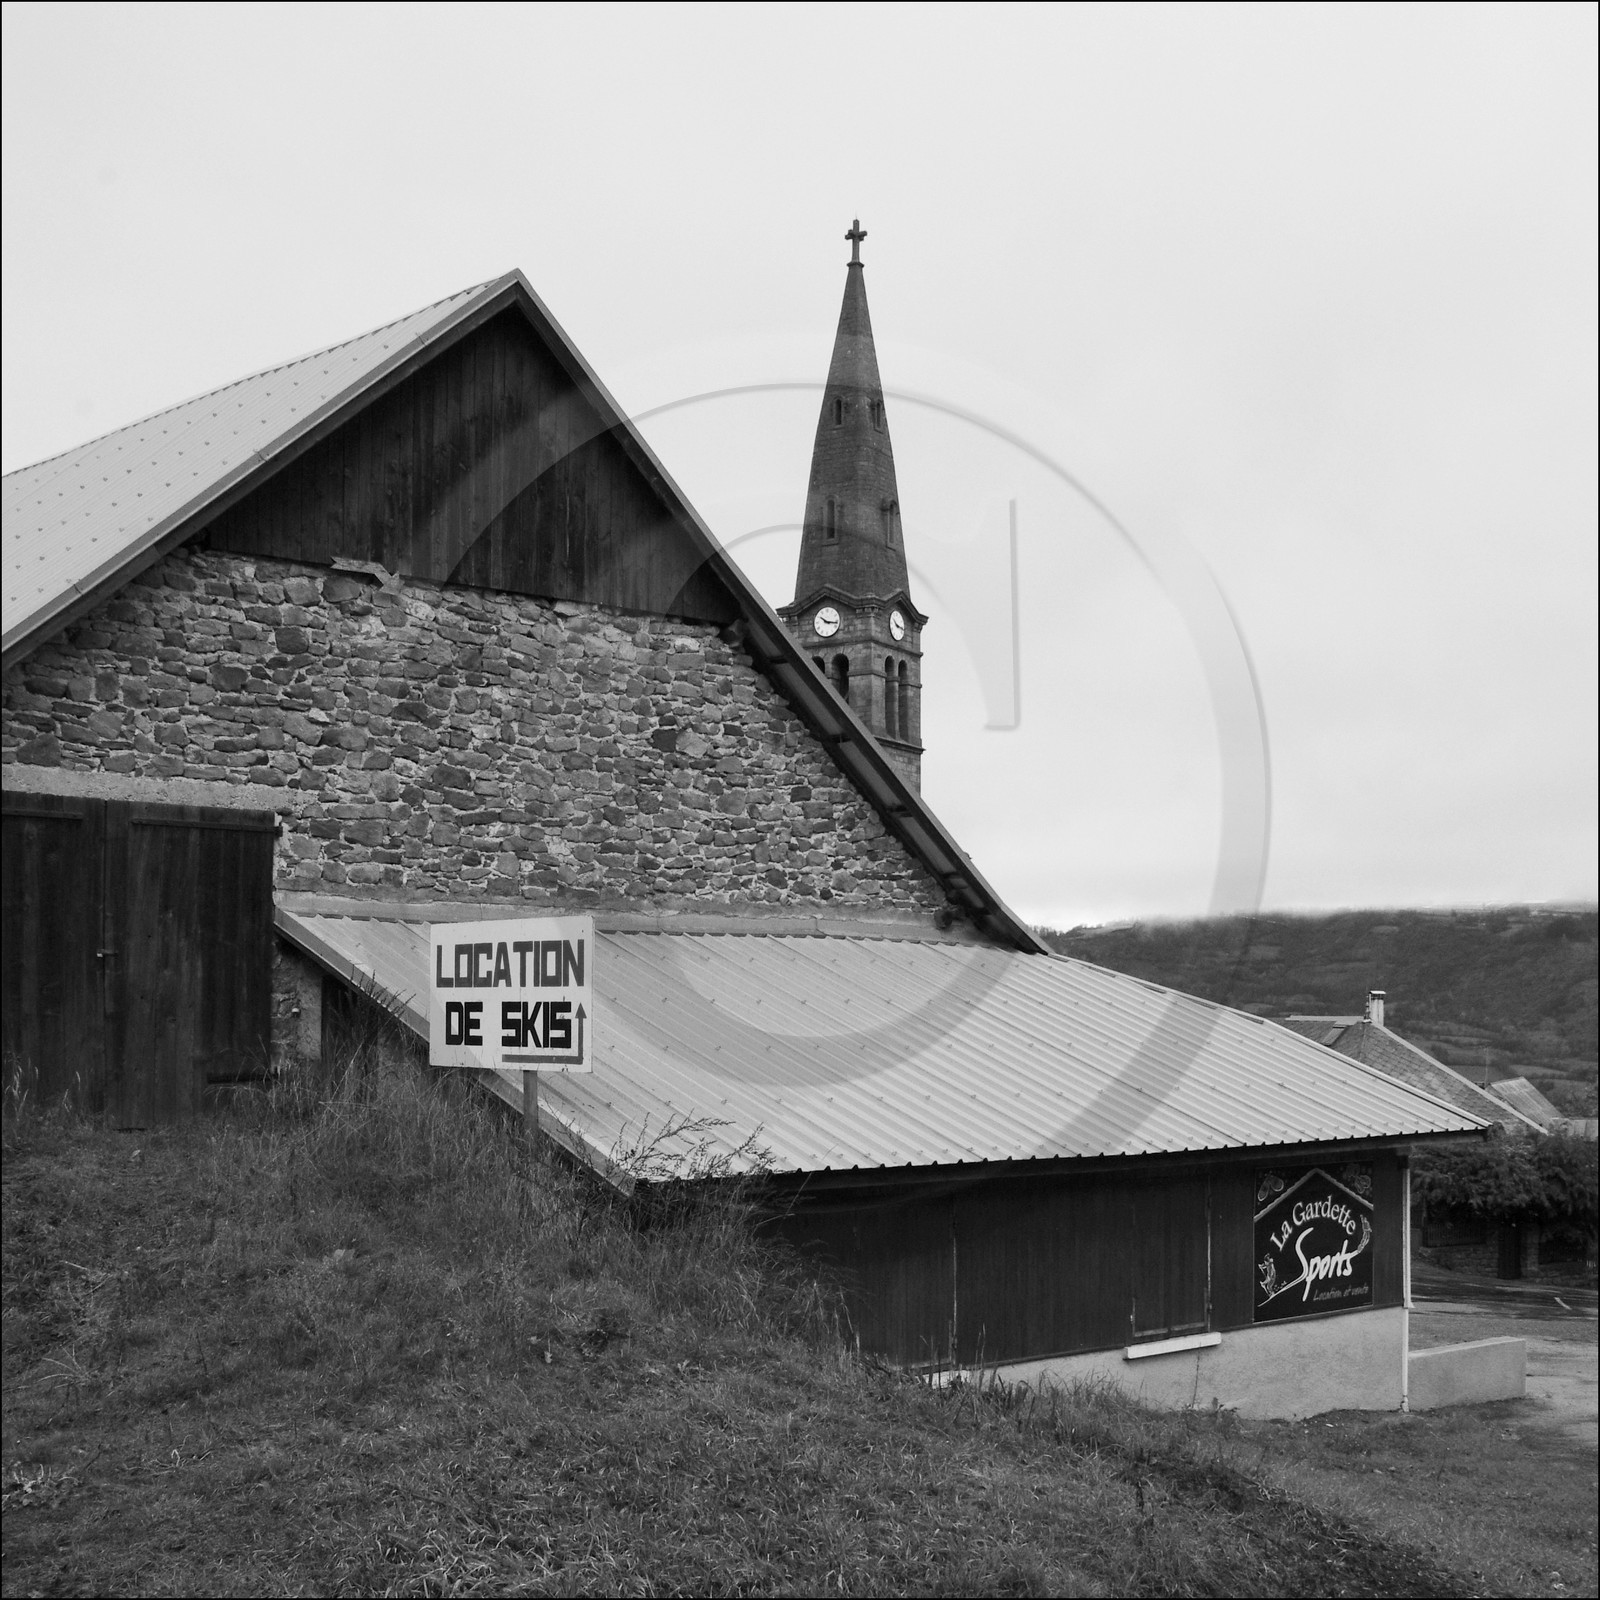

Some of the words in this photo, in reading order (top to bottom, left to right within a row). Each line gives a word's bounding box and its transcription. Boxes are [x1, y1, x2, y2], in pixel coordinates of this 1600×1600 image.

[436, 939, 585, 988] LOCATION
[445, 1001, 483, 1046] DE
[501, 1001, 572, 1049] SKIS
[1270, 1220, 1293, 1251] La
[1292, 1195, 1356, 1235] Gardette
[1294, 1227, 1356, 1302] Sports
